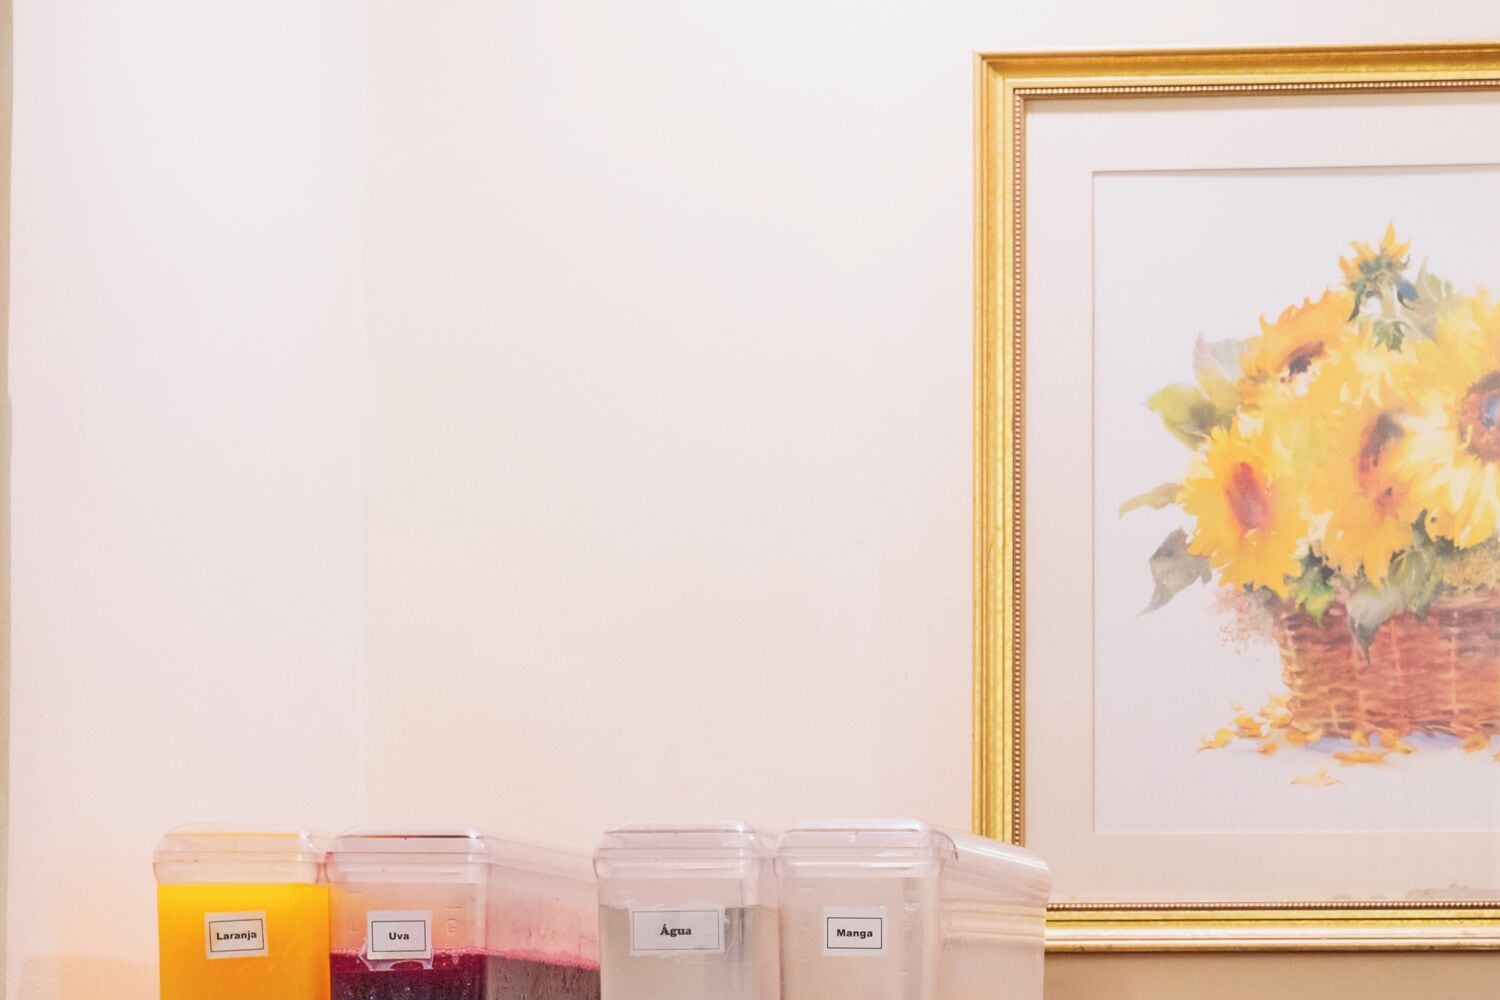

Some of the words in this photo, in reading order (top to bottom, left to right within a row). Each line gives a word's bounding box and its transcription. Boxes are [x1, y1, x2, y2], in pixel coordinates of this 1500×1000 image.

[660, 923, 692, 938] Água
[836, 929, 874, 939] Manga
[216, 931, 257, 941] Laranja
[388, 932, 410, 941] Uva
